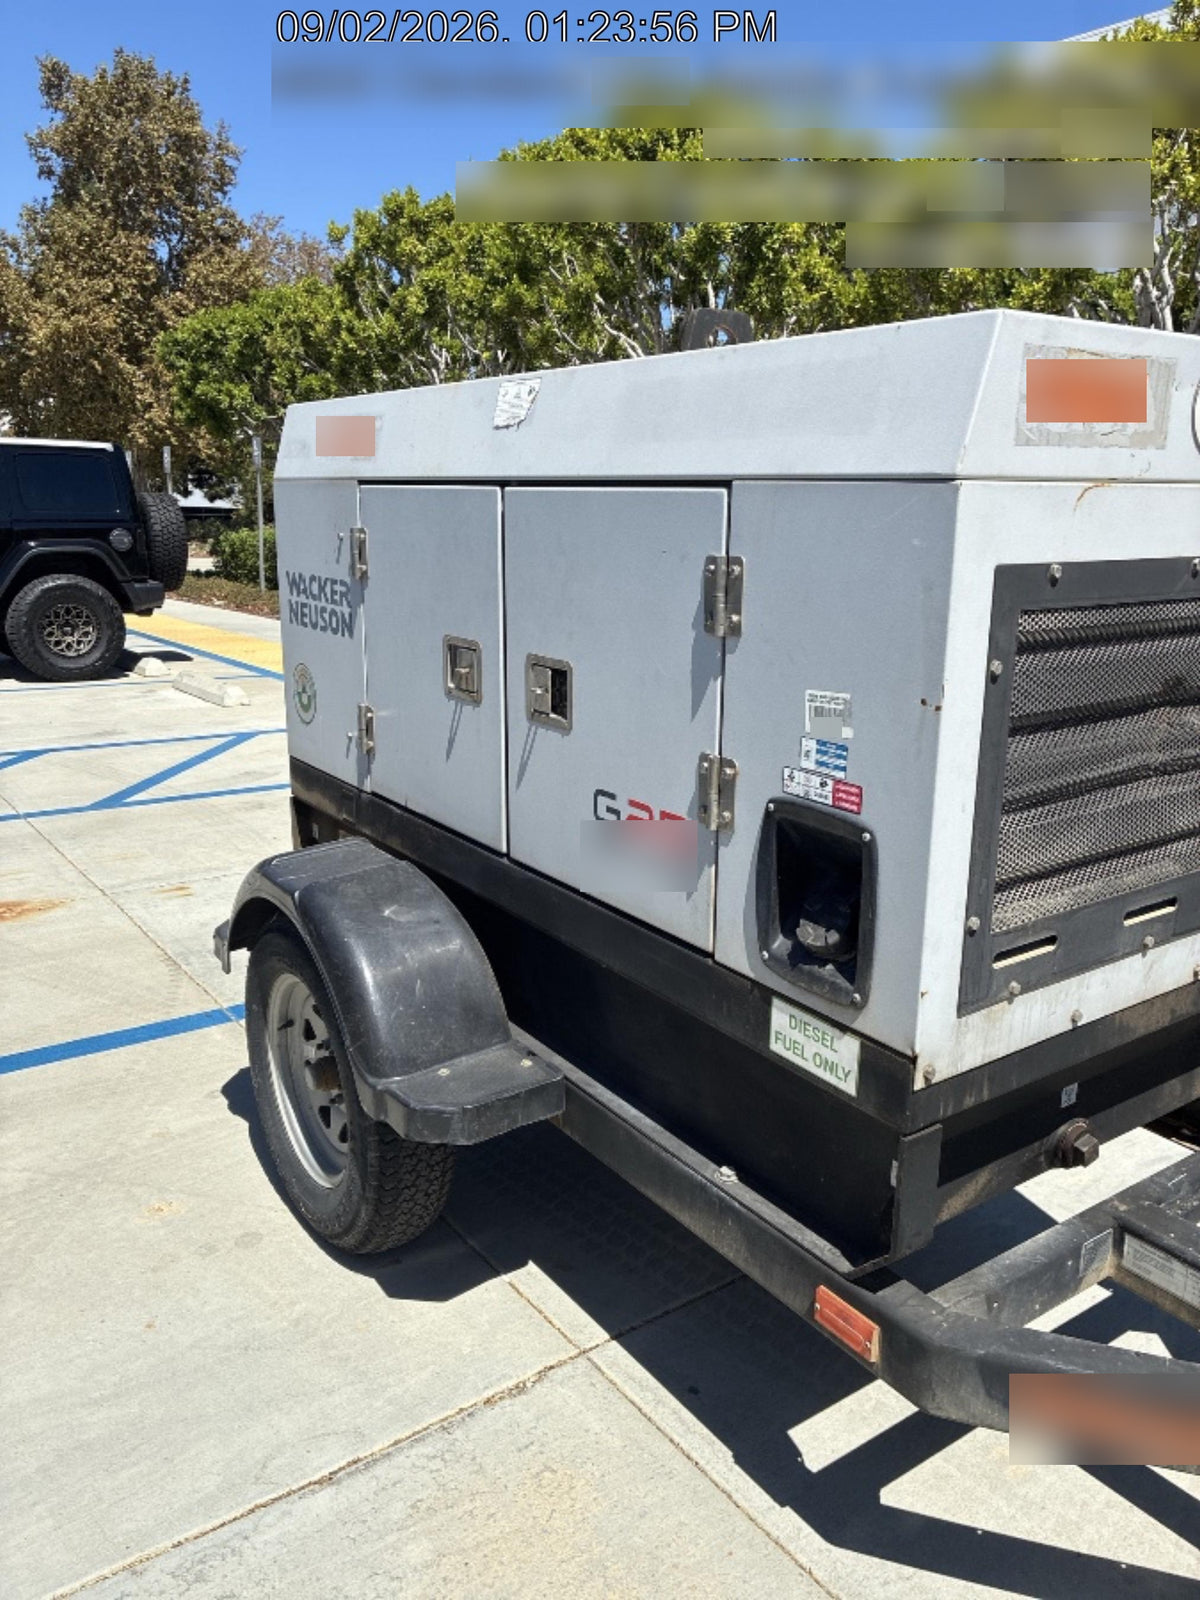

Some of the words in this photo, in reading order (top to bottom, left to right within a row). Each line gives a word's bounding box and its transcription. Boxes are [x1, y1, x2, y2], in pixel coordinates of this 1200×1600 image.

[286, 570, 352, 608] WACKER
[288, 599, 354, 639] NEUSON
[788, 1013, 838, 1053] DIESEL
[774, 1030, 809, 1062] FUEL
[812, 1051, 852, 1083] ONLY
